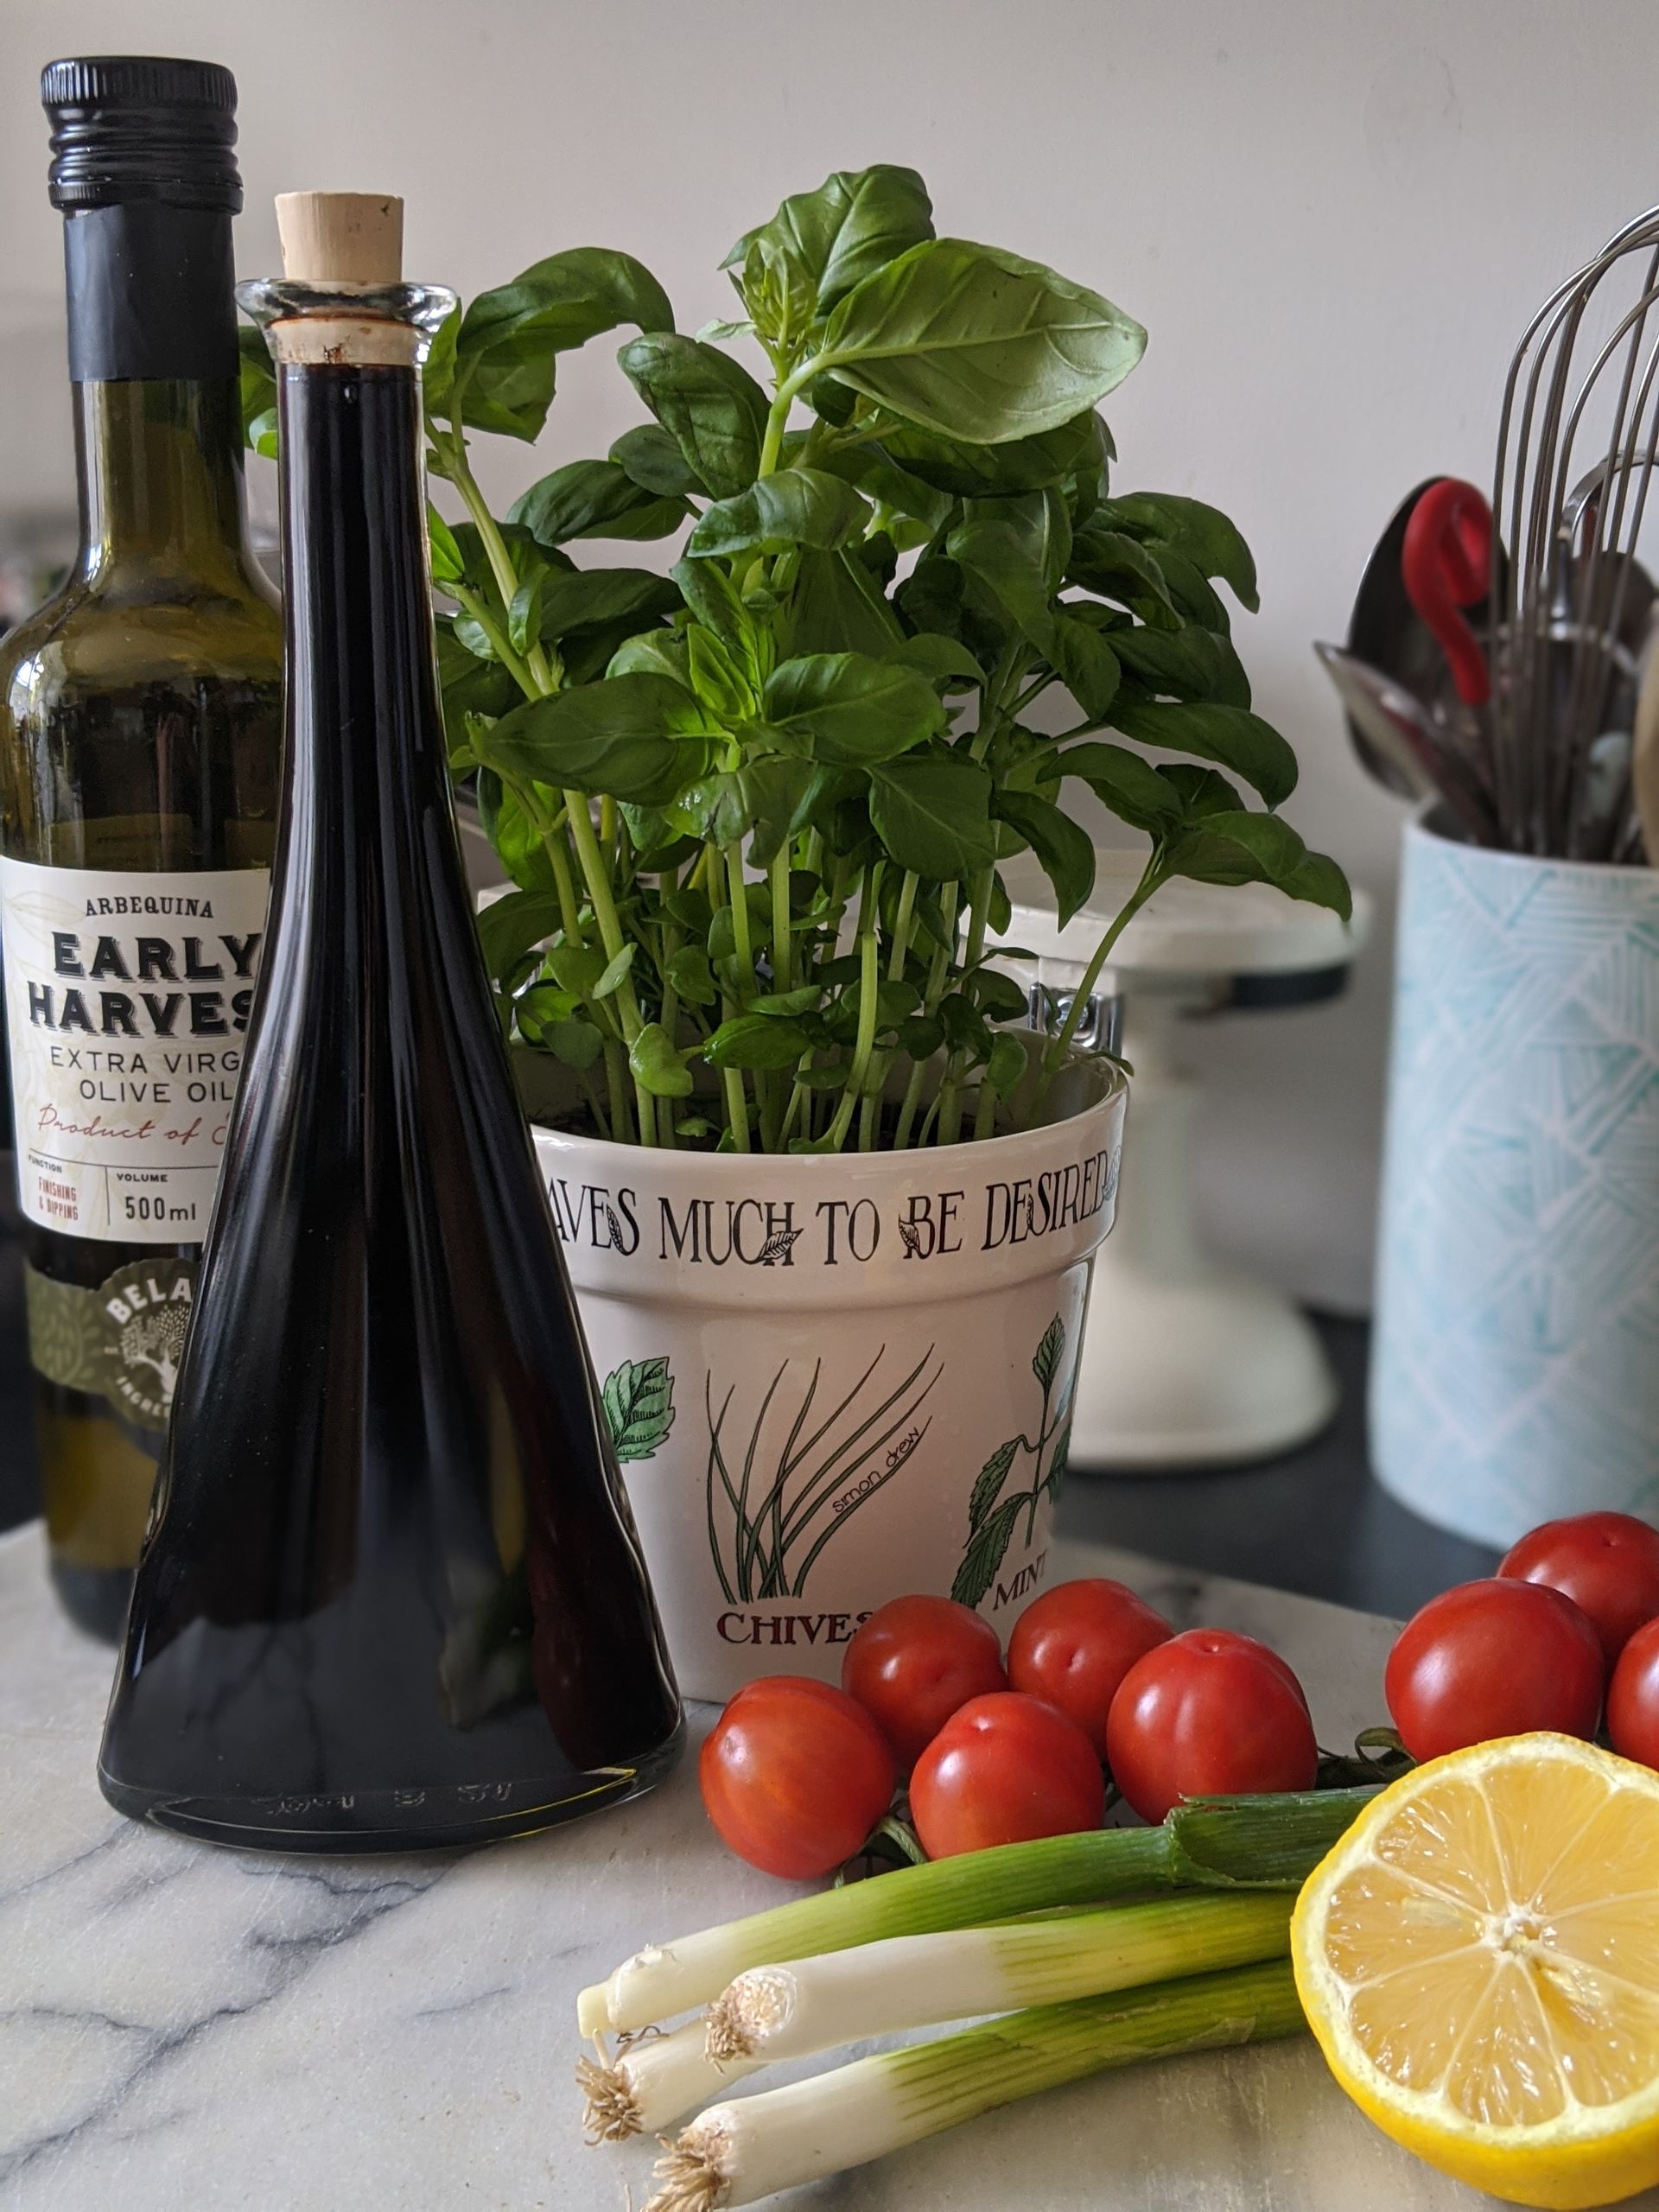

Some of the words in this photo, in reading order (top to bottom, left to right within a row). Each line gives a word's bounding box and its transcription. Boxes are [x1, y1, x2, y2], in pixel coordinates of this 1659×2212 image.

[86, 896, 214, 918] ARBEQUINA
[52, 931, 263, 983] EARLY
[50, 1046, 148, 1074] EXTRA
[163, 1051, 239, 1075] VIRG
[79, 1079, 171, 1103] OLIVE
[188, 1081, 233, 1103] OIL
[38, 1103, 156, 1141] Product
[163, 1117, 203, 1146] of
[28, 1154, 63, 1174] FUNCTION
[38, 1176, 77, 1202] FINISHING
[117, 1173, 168, 1183] VOLUME
[47, 1198, 79, 1221] DIPPING
[124, 1196, 196, 1221] 500ml
[658, 1197, 797, 1267] MUCH
[816, 1198, 880, 1265] TO
[902, 1191, 965, 1260] BE
[981, 1150, 1109, 1251] DESIRED
[106, 1277, 193, 1325] BELA
[832, 1471, 881, 1513] simon
[886, 1427, 920, 1467] drew
